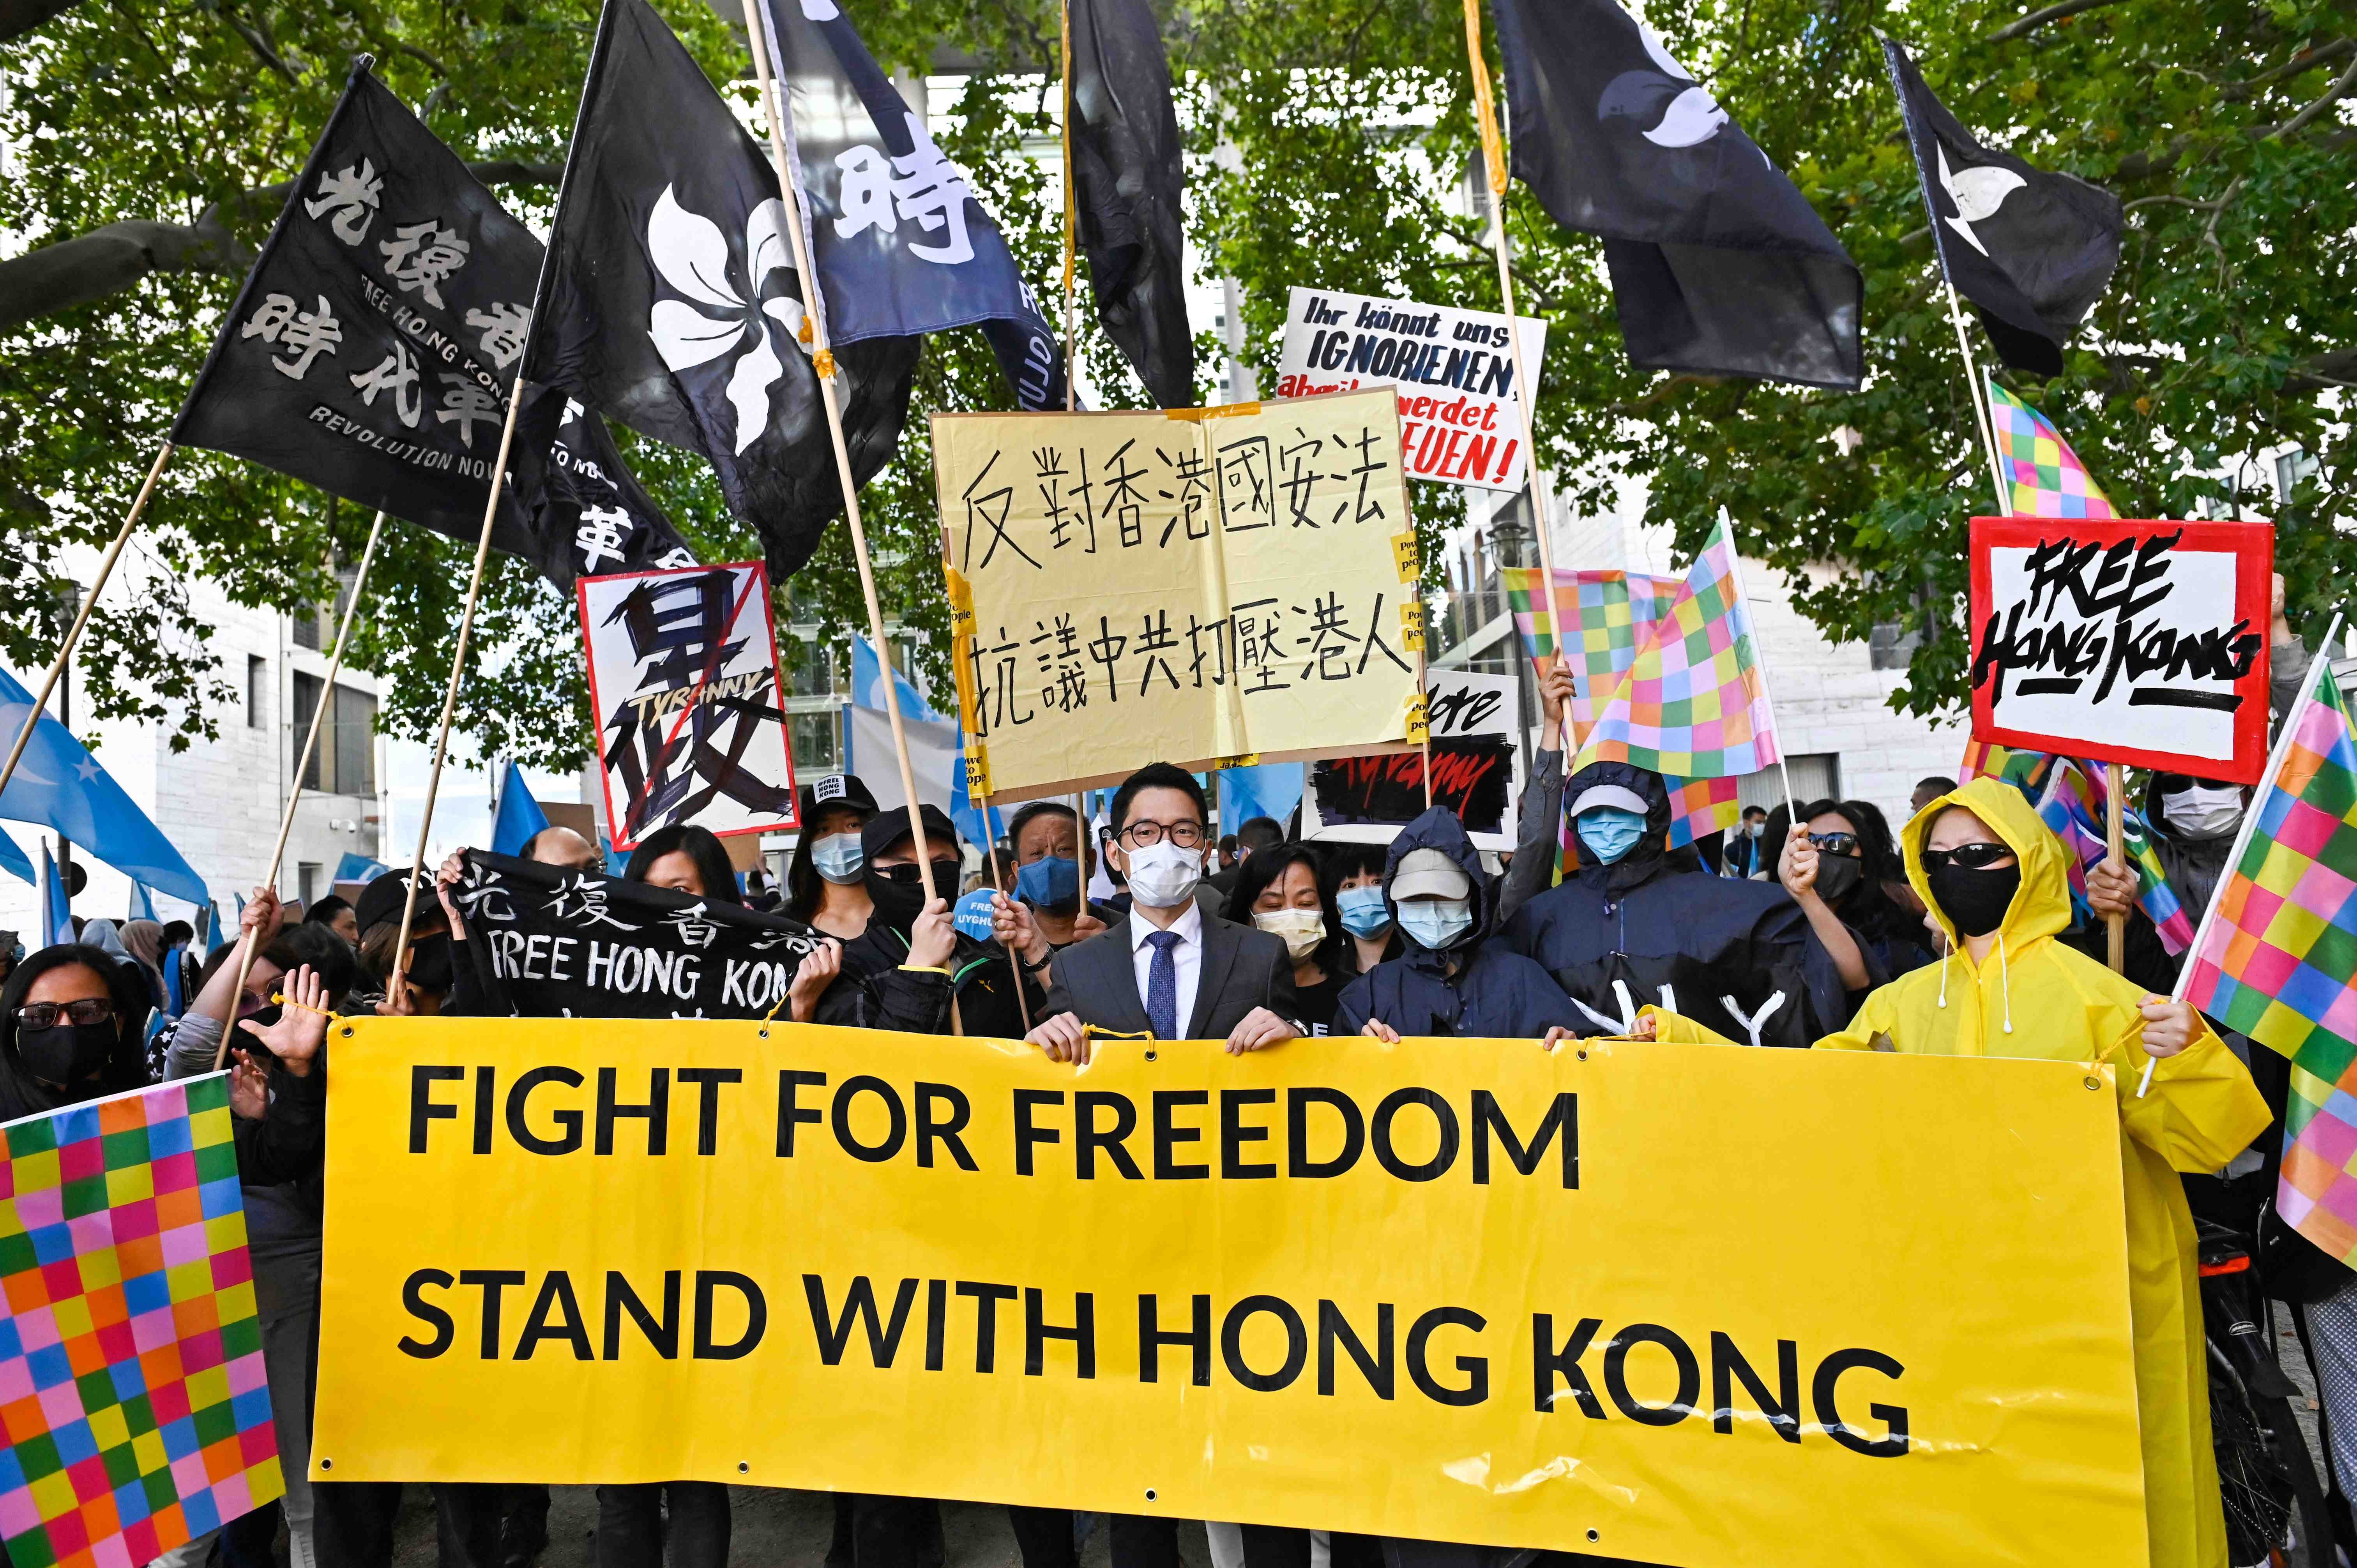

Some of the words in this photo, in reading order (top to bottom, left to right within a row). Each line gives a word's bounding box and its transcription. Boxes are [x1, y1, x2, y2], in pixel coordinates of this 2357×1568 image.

[393, 305, 458, 363] HONG
[1303, 296, 1348, 326] Ihr
[1354, 302, 1442, 338] könnt
[1452, 321, 1509, 349] uns
[309, 405, 452, 470] REVOLUTION
[962, 426, 1387, 574] 反對香港國安法
[2024, 528, 2183, 623] FREE
[968, 592, 1412, 737] 抗議中共打壓港人
[628, 671, 764, 730] TYRANNY
[818, 777, 839, 787] #FREE
[819, 783, 840, 793] HONG
[820, 788, 840, 799] KONG
[488, 930, 578, 980] FREE
[587, 940, 701, 1000] HONG
[409, 1065, 742, 1156] FIGHT
[776, 1070, 980, 1171] FOR
[1013, 1087, 1579, 1190] FREEDOM
[397, 1268, 767, 1361] STAND
[802, 1274, 1095, 1379] WITH
[1138, 1294, 1488, 1406] HONG
[1533, 1313, 1909, 1458] KONG
